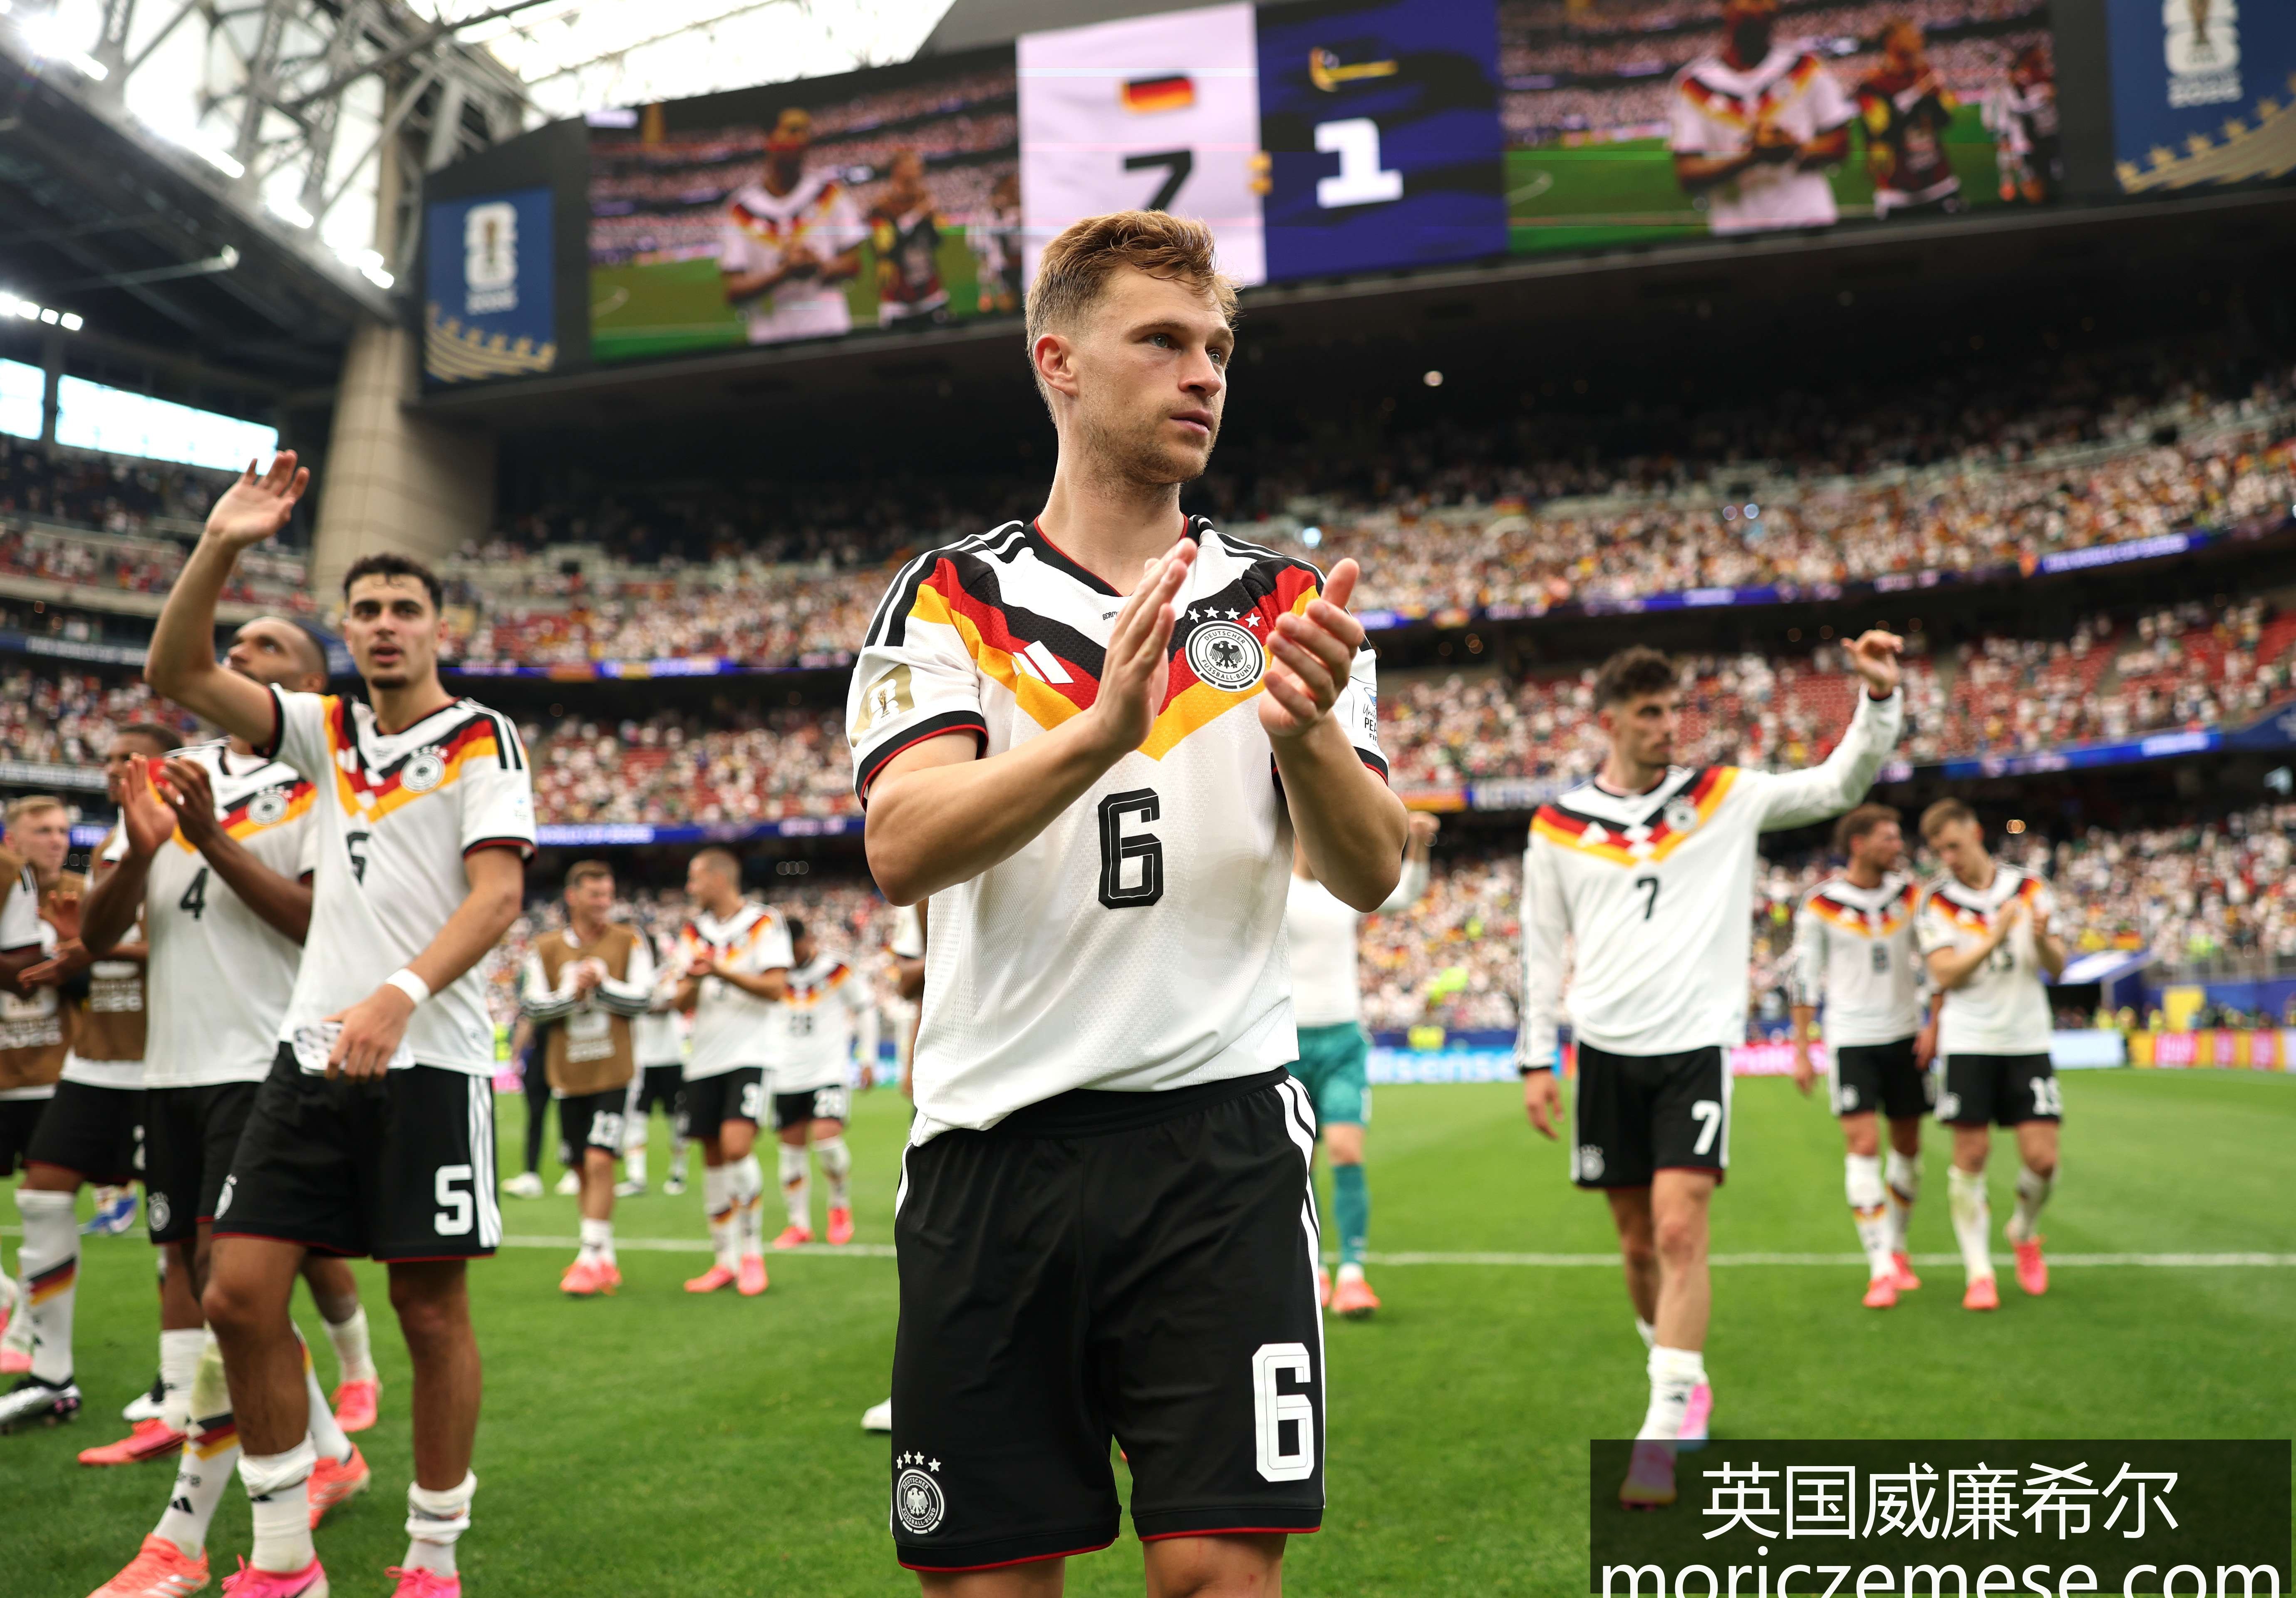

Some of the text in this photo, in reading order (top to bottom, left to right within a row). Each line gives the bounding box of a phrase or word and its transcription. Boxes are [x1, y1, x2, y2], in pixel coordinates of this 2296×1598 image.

[1123, 149, 1194, 211] 7
[1314, 117, 1404, 209] 1
[1103, 611, 1118, 620] GERM
[1204, 631, 1246, 644] DEUTSCHER
[1201, 659, 1252, 680] FUSSBALL-BUND
[1365, 717, 1377, 733] PEA
[1369, 733, 1378, 741] FIF
[1098, 787, 1163, 909] 6
[180, 867, 208, 919] 4
[1636, 876, 1659, 920] 7
[1691, 1099, 1722, 1155] 7
[434, 1164, 474, 1236] 5
[1252, 1343, 1314, 1482] 6
[903, 1478, 929, 1490] DEUTSCHER
[902, 1507, 936, 1526] FUSSBALL-BUND
